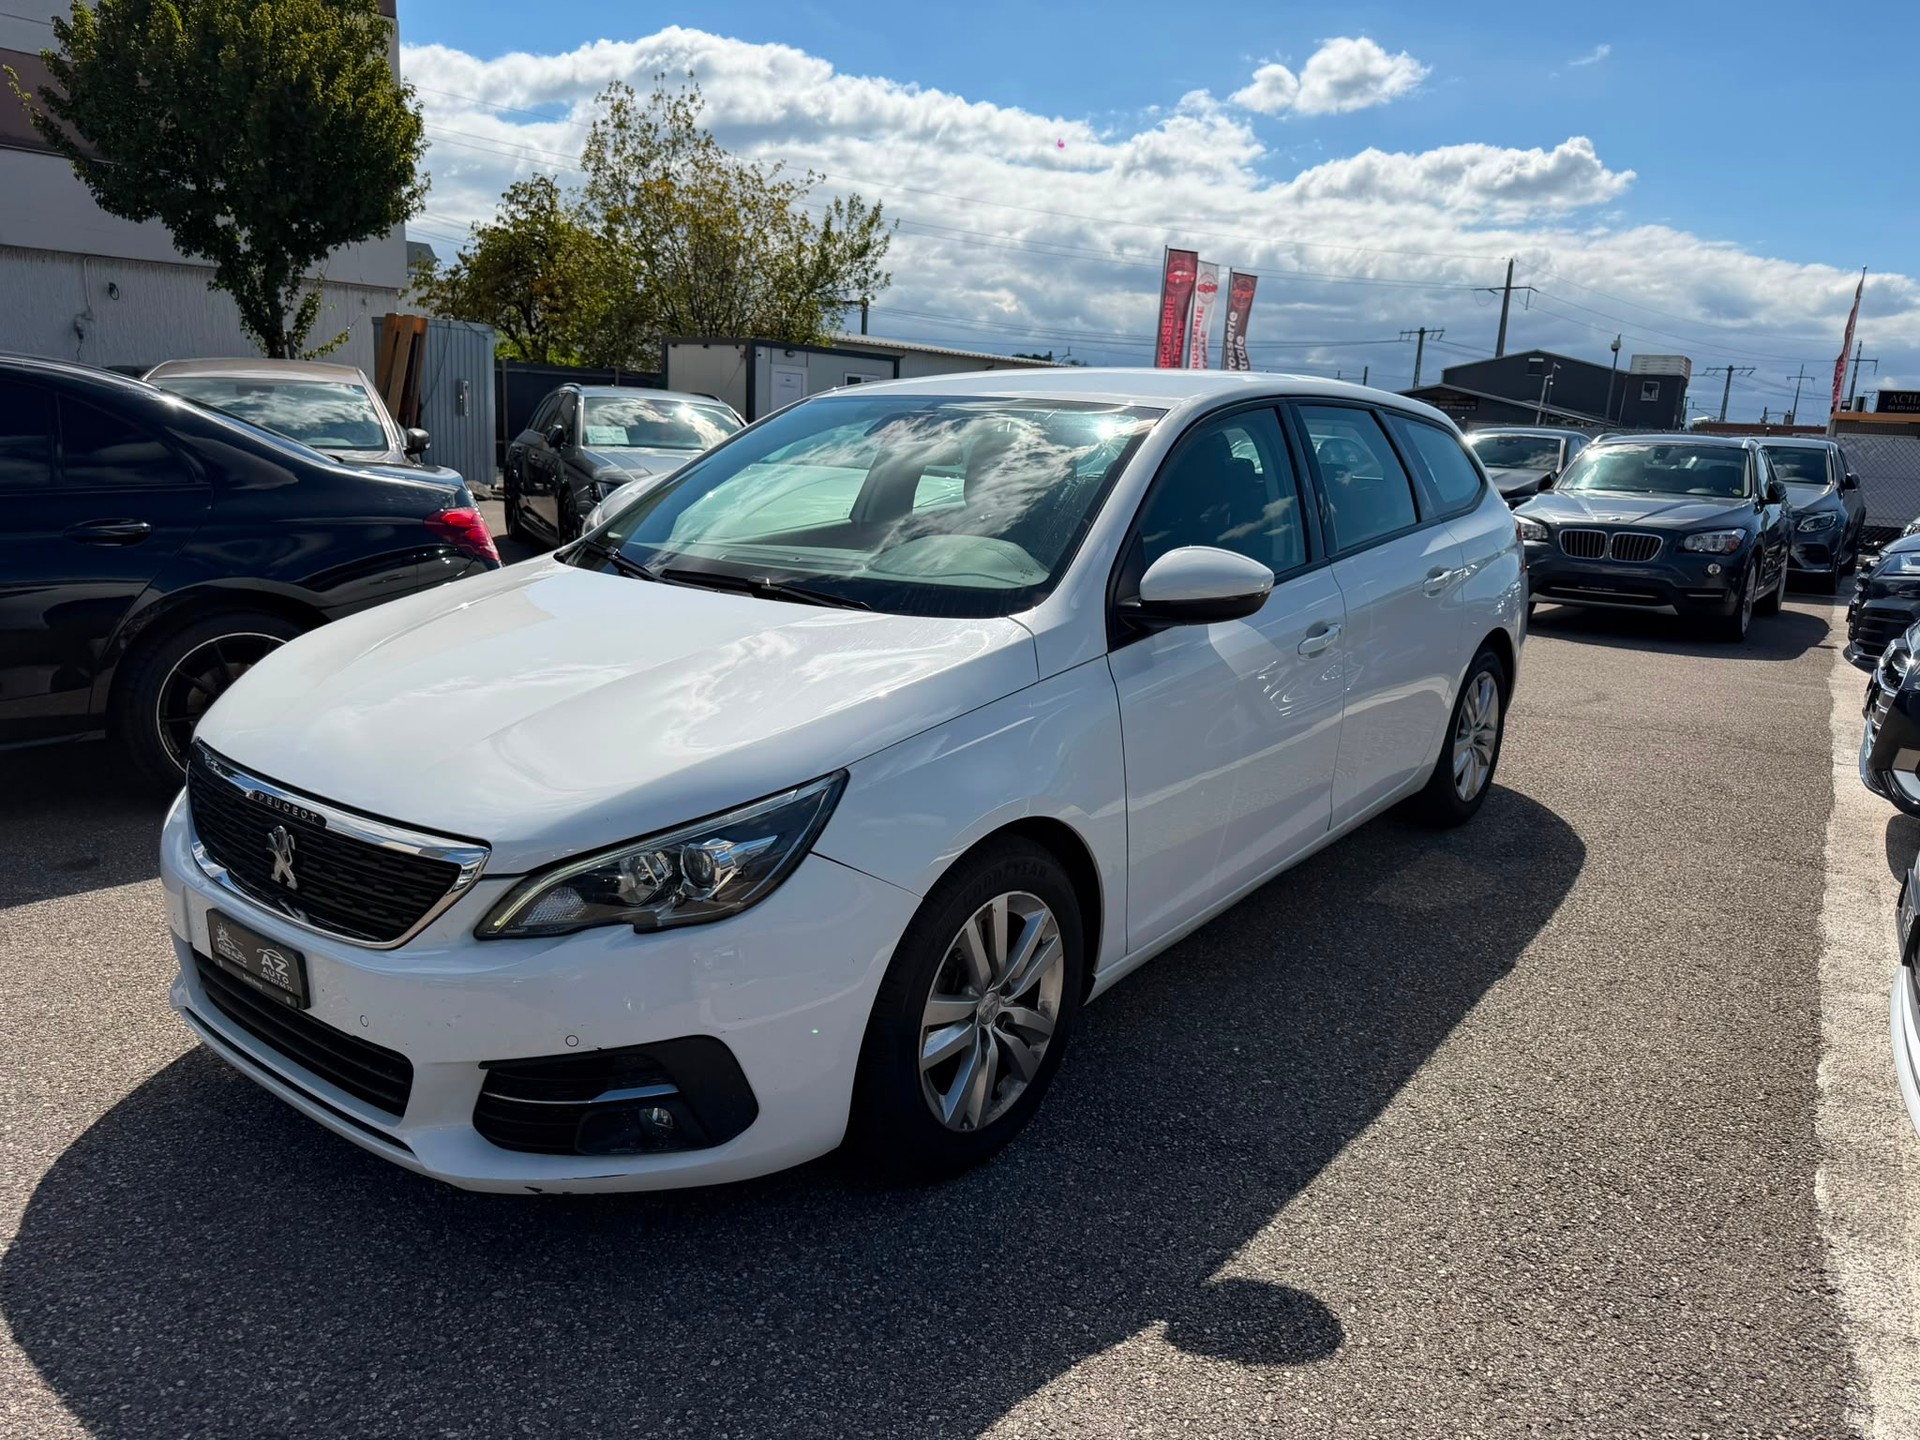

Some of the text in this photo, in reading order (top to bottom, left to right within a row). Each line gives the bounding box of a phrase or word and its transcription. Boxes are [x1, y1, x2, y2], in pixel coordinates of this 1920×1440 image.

[259, 794, 317, 822] PEUGEOT
[261, 954, 288, 977] AZ
[262, 967, 289, 984] AUTO
